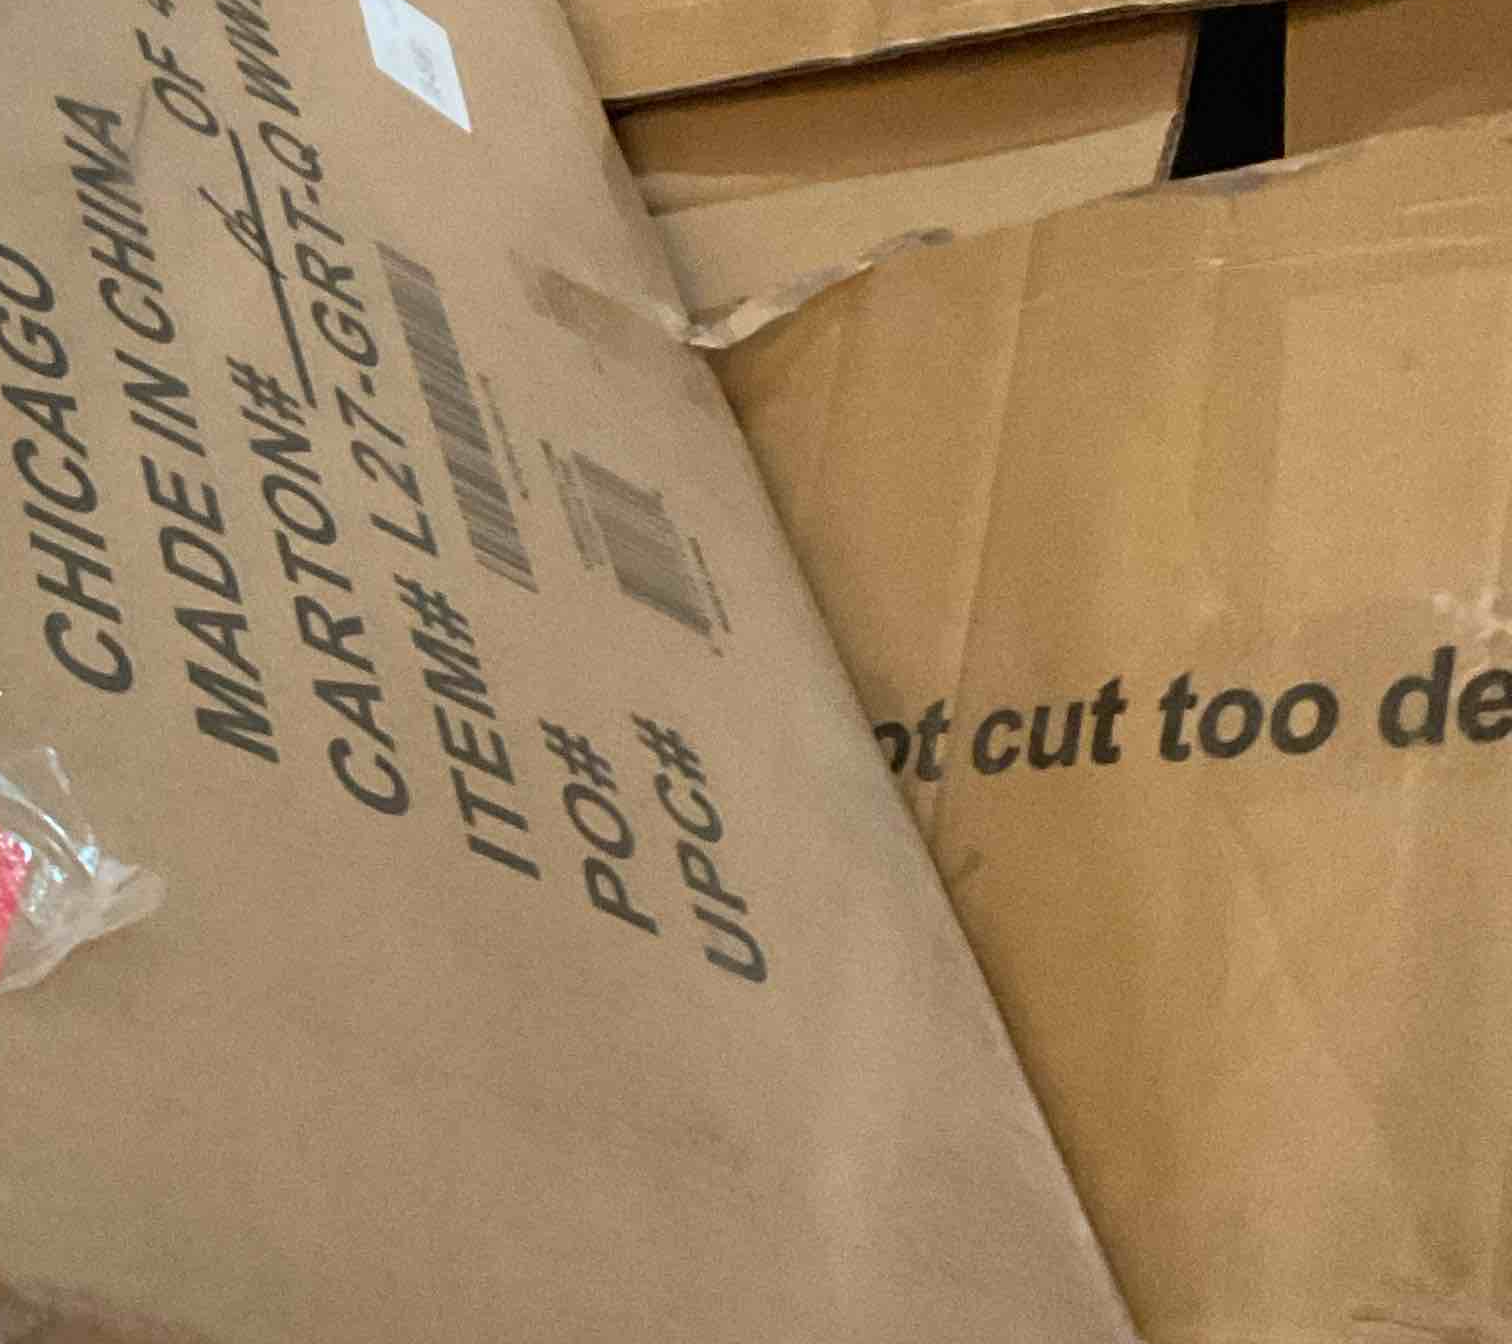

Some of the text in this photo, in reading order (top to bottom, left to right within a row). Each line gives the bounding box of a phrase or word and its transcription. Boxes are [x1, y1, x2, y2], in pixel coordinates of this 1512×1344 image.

[136, 29, 219, 137] OF
[56, 95, 279, 763] MADE IN CHINA
[258, 121, 439, 558] L27-GRT-Q
[225, 357, 410, 816] CARTON#
[394, 572, 541, 881] ITEM#
[872, 645, 1512, 782] ot cut too de
[538, 716, 660, 936] PO#
[631, 712, 767, 984] UPC#
